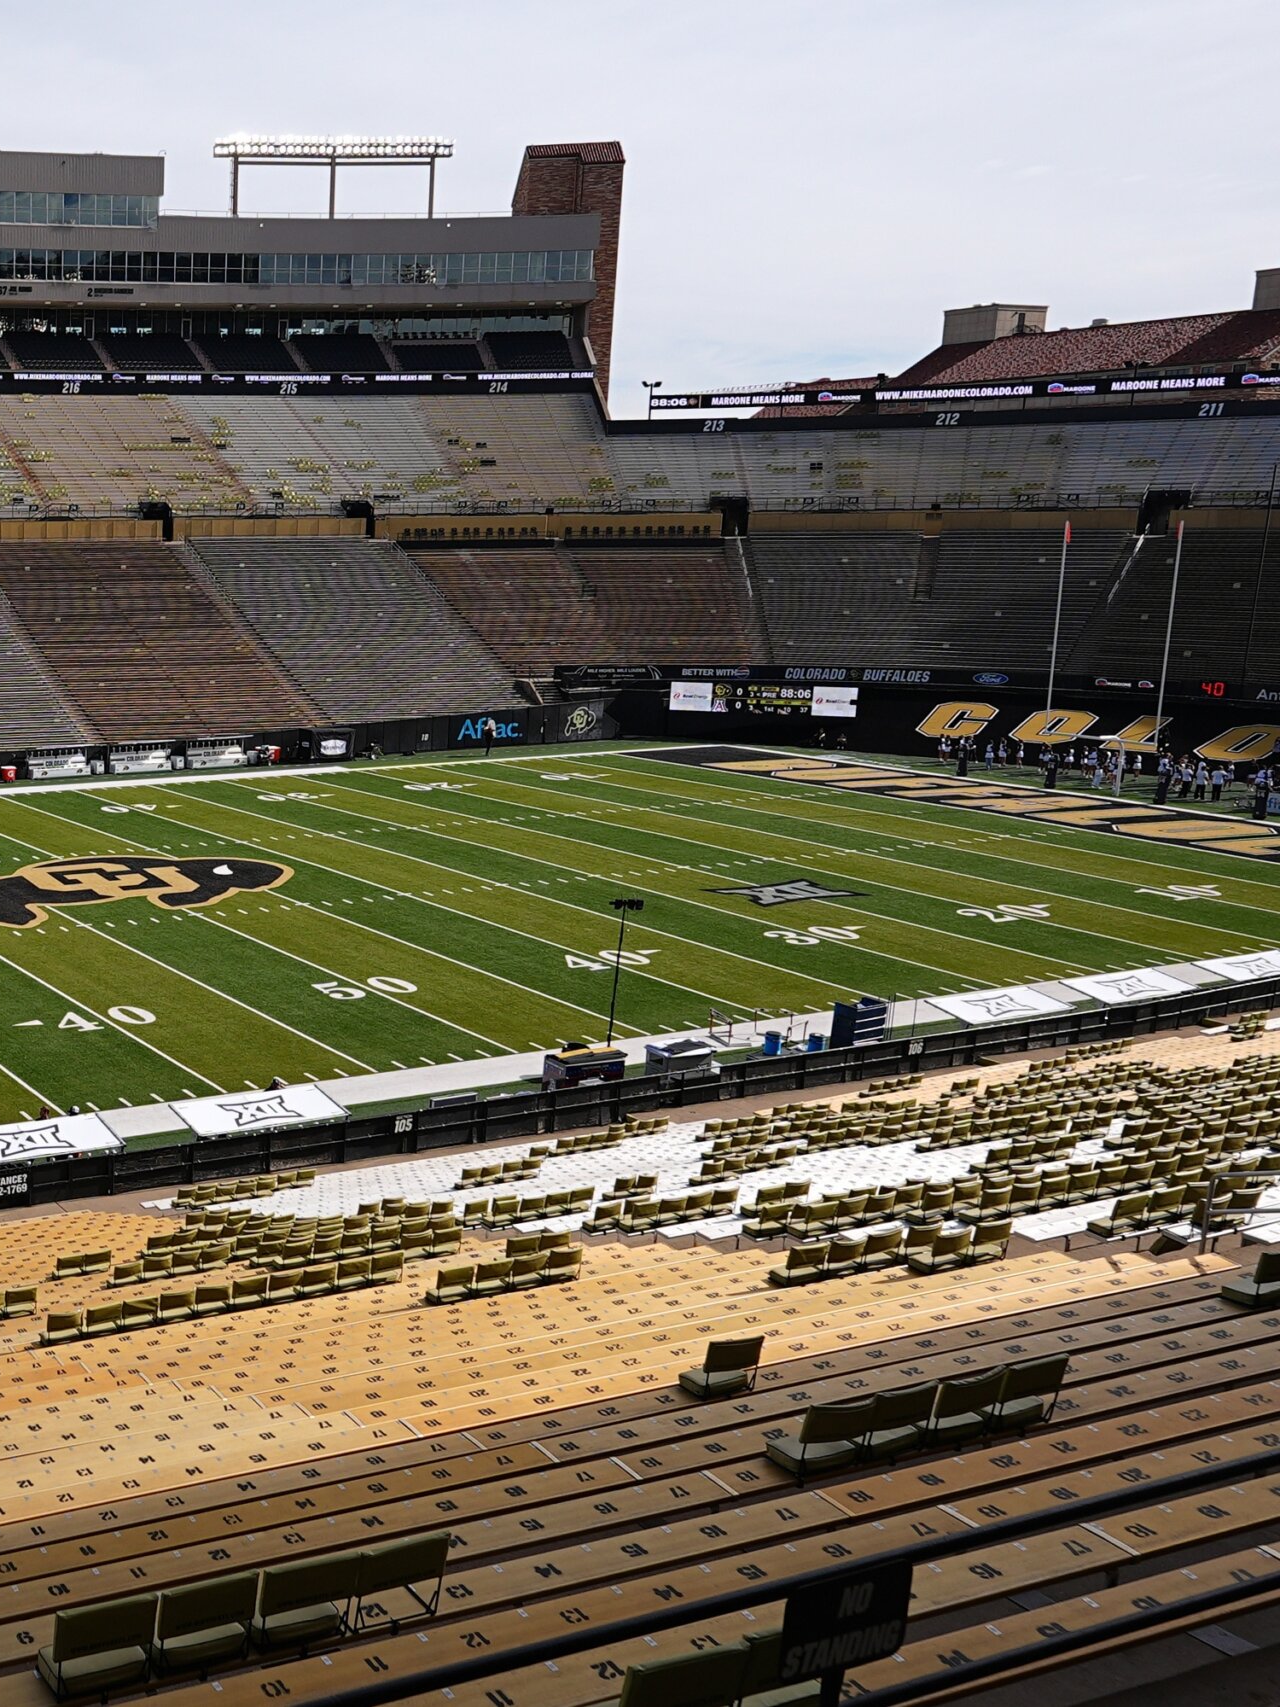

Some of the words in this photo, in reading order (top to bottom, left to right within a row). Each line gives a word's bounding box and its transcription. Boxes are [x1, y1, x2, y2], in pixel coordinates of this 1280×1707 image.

[87, 288, 93, 297] 2
[61, 382, 81, 393] 216
[279, 383, 298, 394] 215
[489, 382, 508, 393] 214
[1111, 379, 1158, 391] MAROONE
[1160, 378, 1195, 389] MEANS
[1196, 376, 1226, 387] MORE
[711, 396, 751, 406] MAROONE
[751, 395, 780, 405] MEANS
[780, 394, 805, 404] MORE
[875, 385, 1033, 401] WWW.MIKEMAROONECOLORADO.COM
[650, 398, 688, 407] 88:06
[1198, 403, 1225, 416] 211
[703, 420, 725, 432] 213
[935, 413, 961, 425] 212
[681, 668, 714, 676] BETTER
[715, 668, 737, 676] WITH
[784, 667, 847, 680] COLORADO
[862, 668, 931, 682] BUFFALOES
[978, 673, 1002, 684] Ford
[736, 687, 743, 696] 0
[780, 688, 811, 699] 88:06
[1201, 681, 1225, 697] 40
[735, 701, 742, 709] 0
[457, 717, 523, 741] Afac.
[1135, 883, 1223, 903] 10
[956, 903, 1039, 924] 20
[763, 924, 861, 947] 30
[565, 948, 651, 972] 40
[312, 975, 418, 1000] 50
[56, 1005, 157, 1033] 40
[908, 1042, 924, 1056] 106
[394, 1118, 413, 1133] 105
[837, 1581, 875, 1618] NO
[781, 1618, 903, 1680] STANDING
